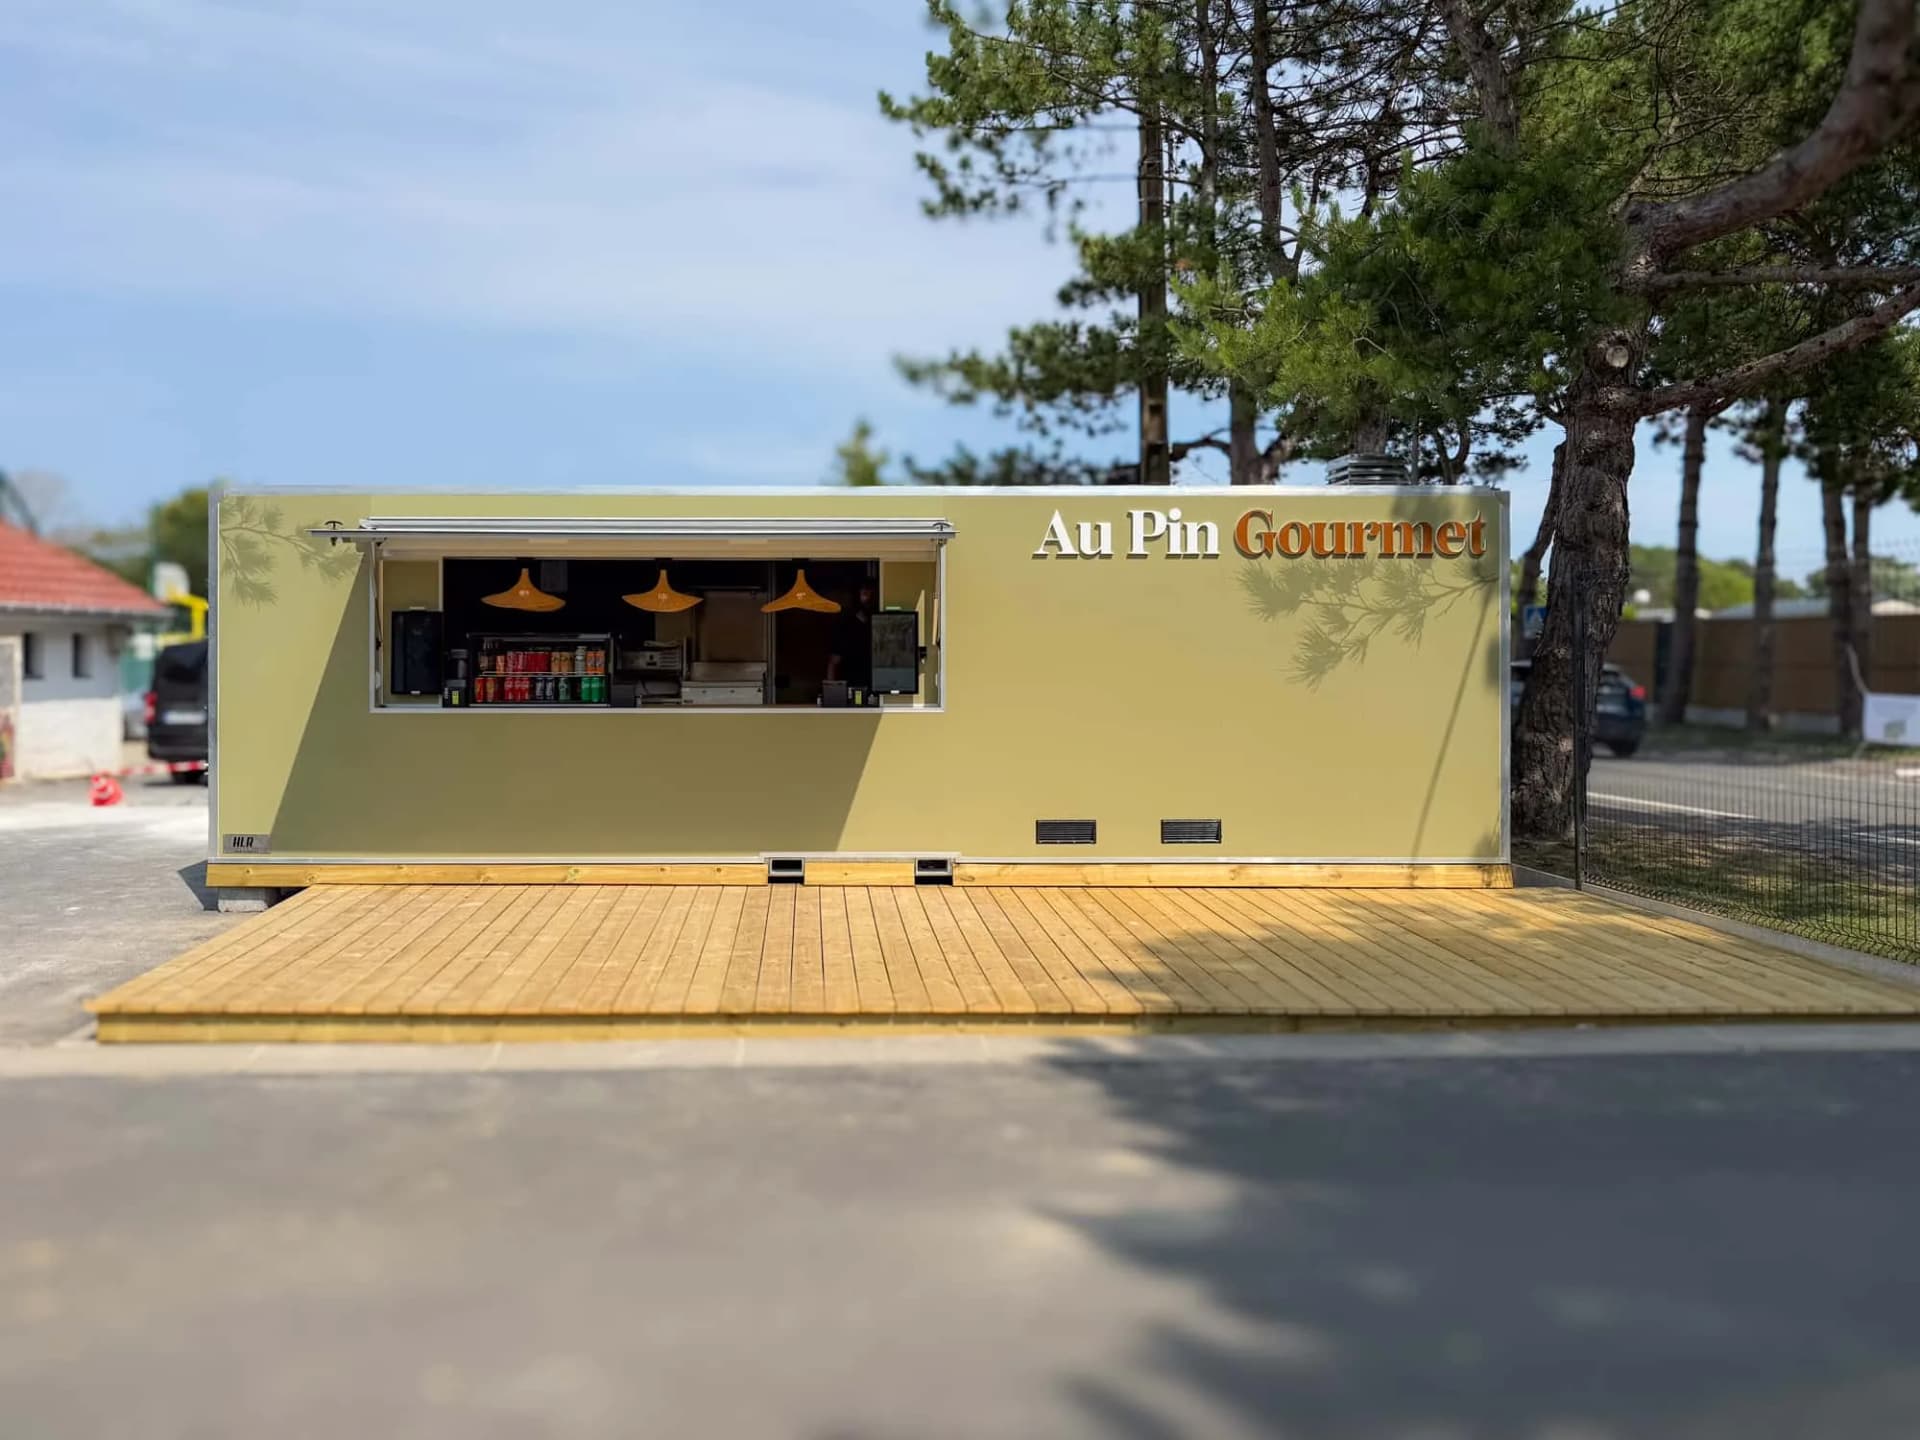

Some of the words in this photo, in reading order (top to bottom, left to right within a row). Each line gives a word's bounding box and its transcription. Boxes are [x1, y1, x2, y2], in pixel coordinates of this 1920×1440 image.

[1034, 508, 1113, 558] Au
[1127, 507, 1220, 558] Pin
[1234, 509, 1487, 559] Gourmet
[232, 836, 254, 848] HLR
